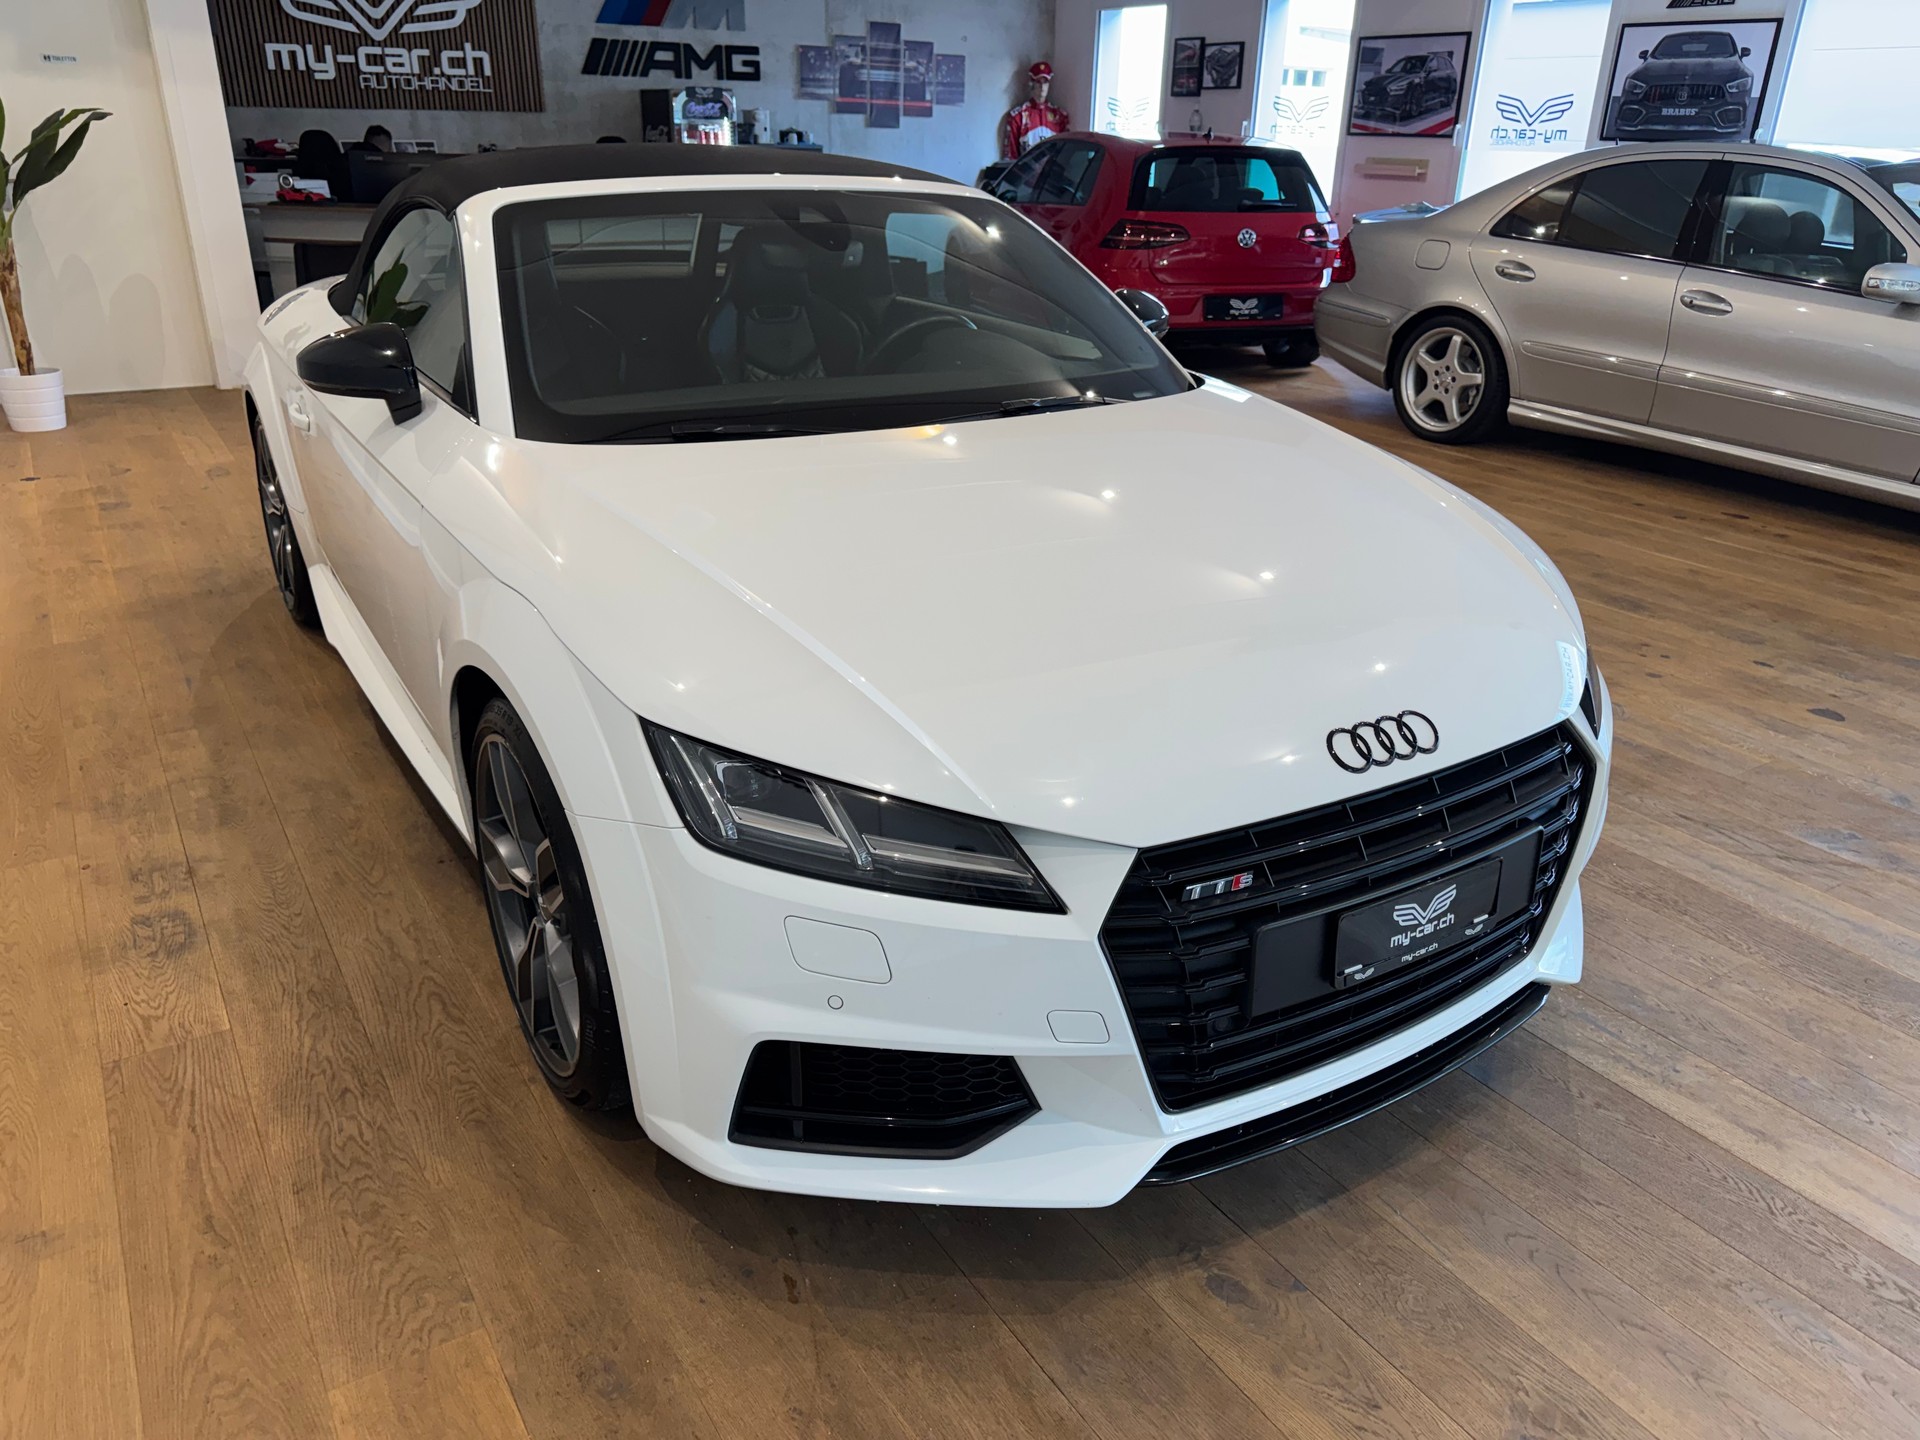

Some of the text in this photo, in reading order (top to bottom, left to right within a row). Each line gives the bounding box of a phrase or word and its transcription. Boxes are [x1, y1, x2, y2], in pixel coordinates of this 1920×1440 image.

[264, 42, 493, 80] my-car.ch
[639, 41, 762, 82] AMG
[359, 74, 494, 93] AUTOHANDEL
[1661, 107, 1698, 116] BRABUS
[1185, 873, 1254, 901] TTS
[1389, 912, 1456, 949] my-car.ch
[1401, 942, 1439, 963] my-car.ch
